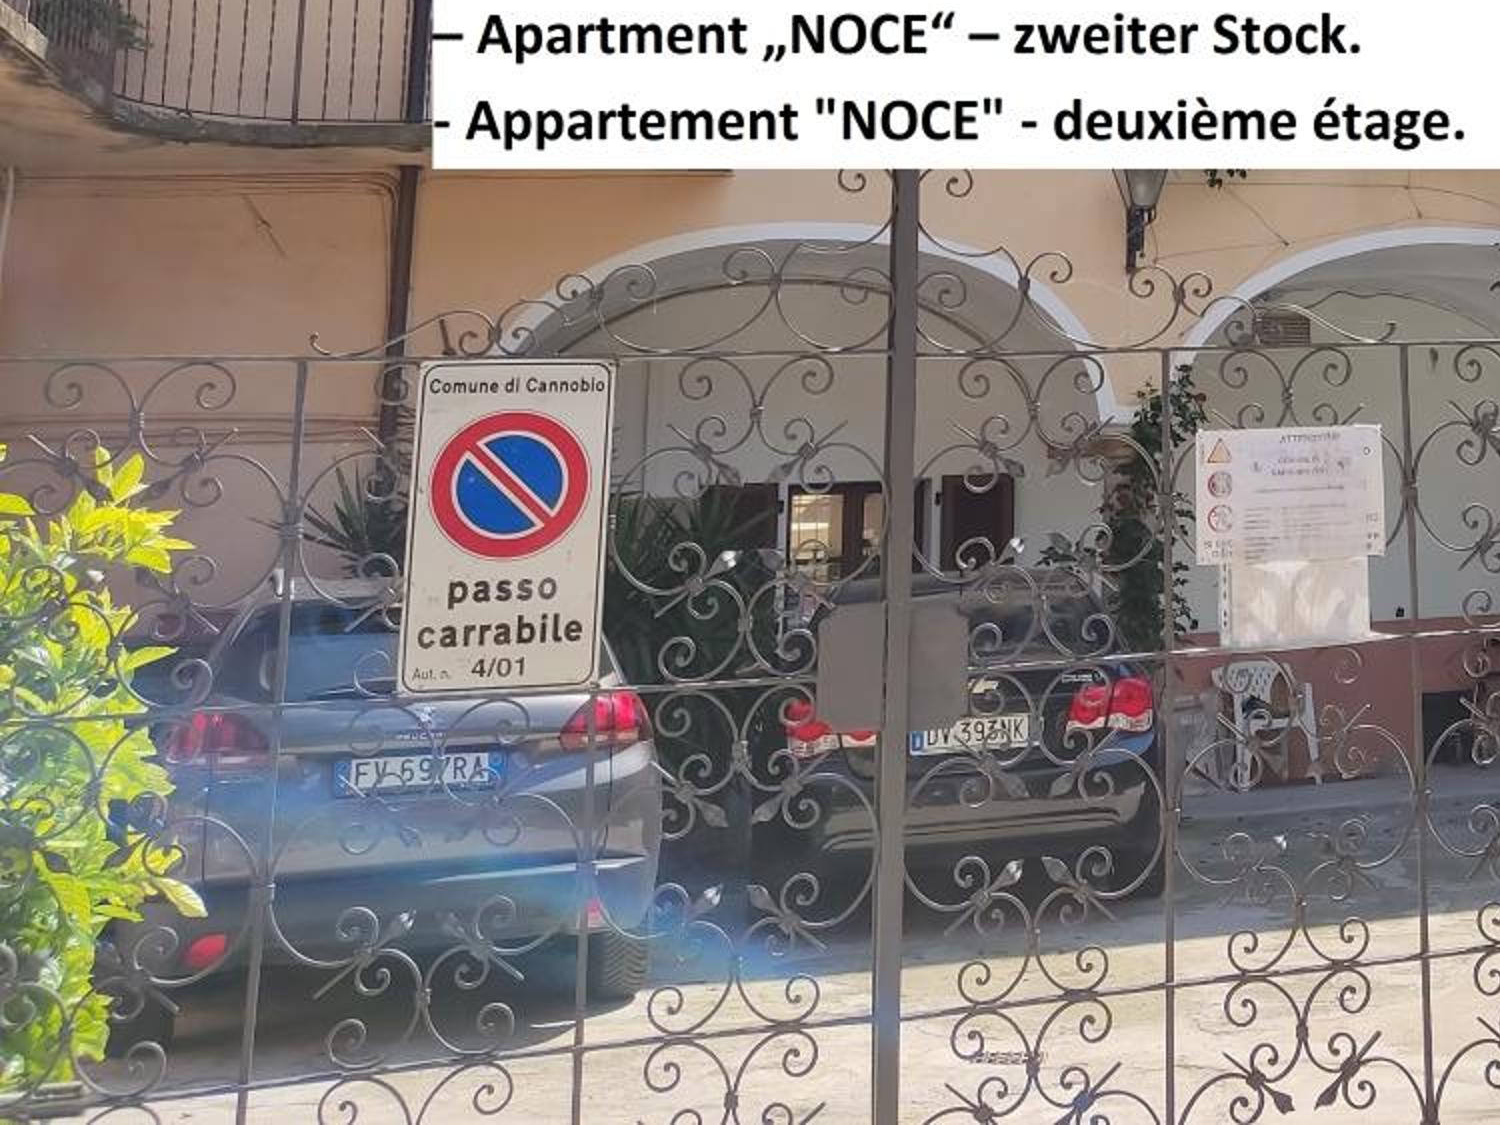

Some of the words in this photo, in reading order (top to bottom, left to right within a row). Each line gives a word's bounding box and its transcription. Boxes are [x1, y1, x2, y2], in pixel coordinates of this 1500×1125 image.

[429, 378, 499, 394] Comune
[504, 377, 520, 393] di
[526, 376, 606, 393] Cannobio
[447, 577, 557, 609] passo
[417, 613, 583, 649] carrabile
[471, 656, 526, 678] 4/01
